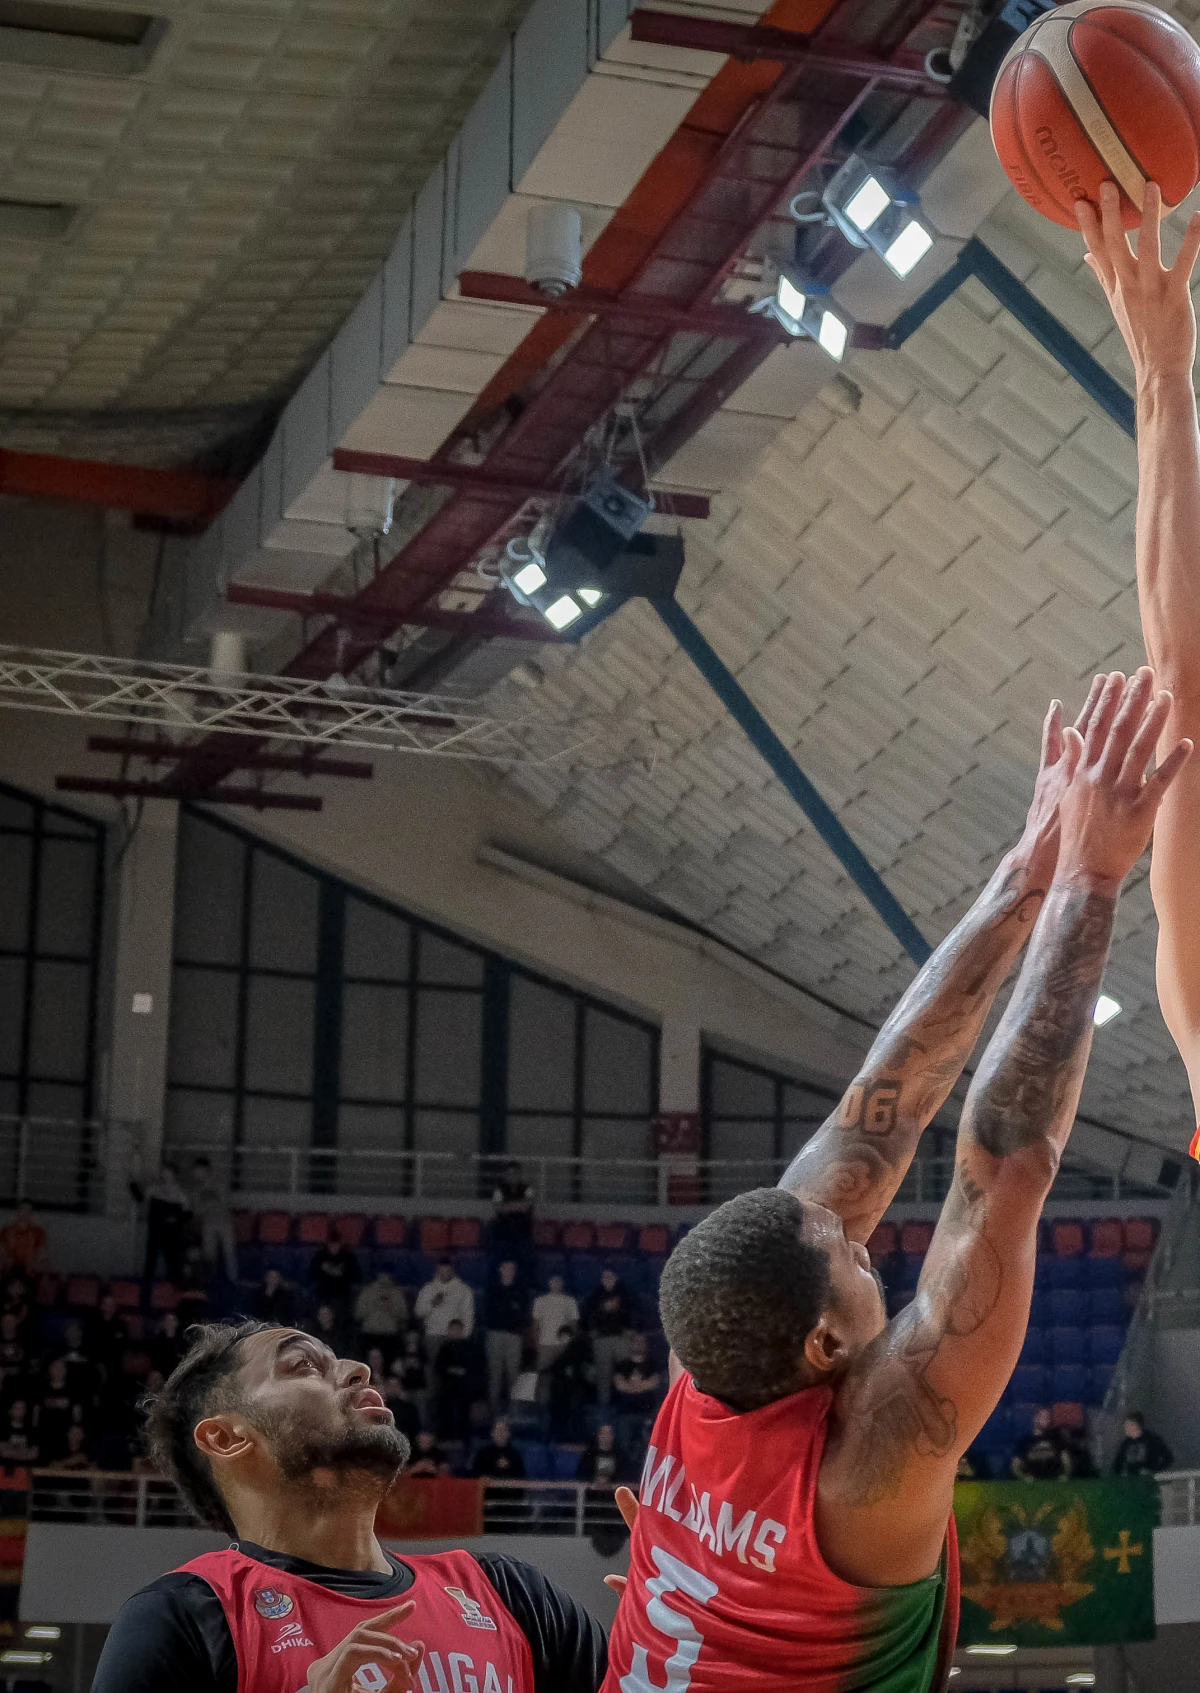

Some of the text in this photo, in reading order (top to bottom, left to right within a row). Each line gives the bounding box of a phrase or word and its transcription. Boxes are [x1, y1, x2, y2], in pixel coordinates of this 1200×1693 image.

[1036, 125, 1094, 206] molte
[271, 1637, 315, 1654] DHIKA
[619, 1544, 719, 1693] 5
